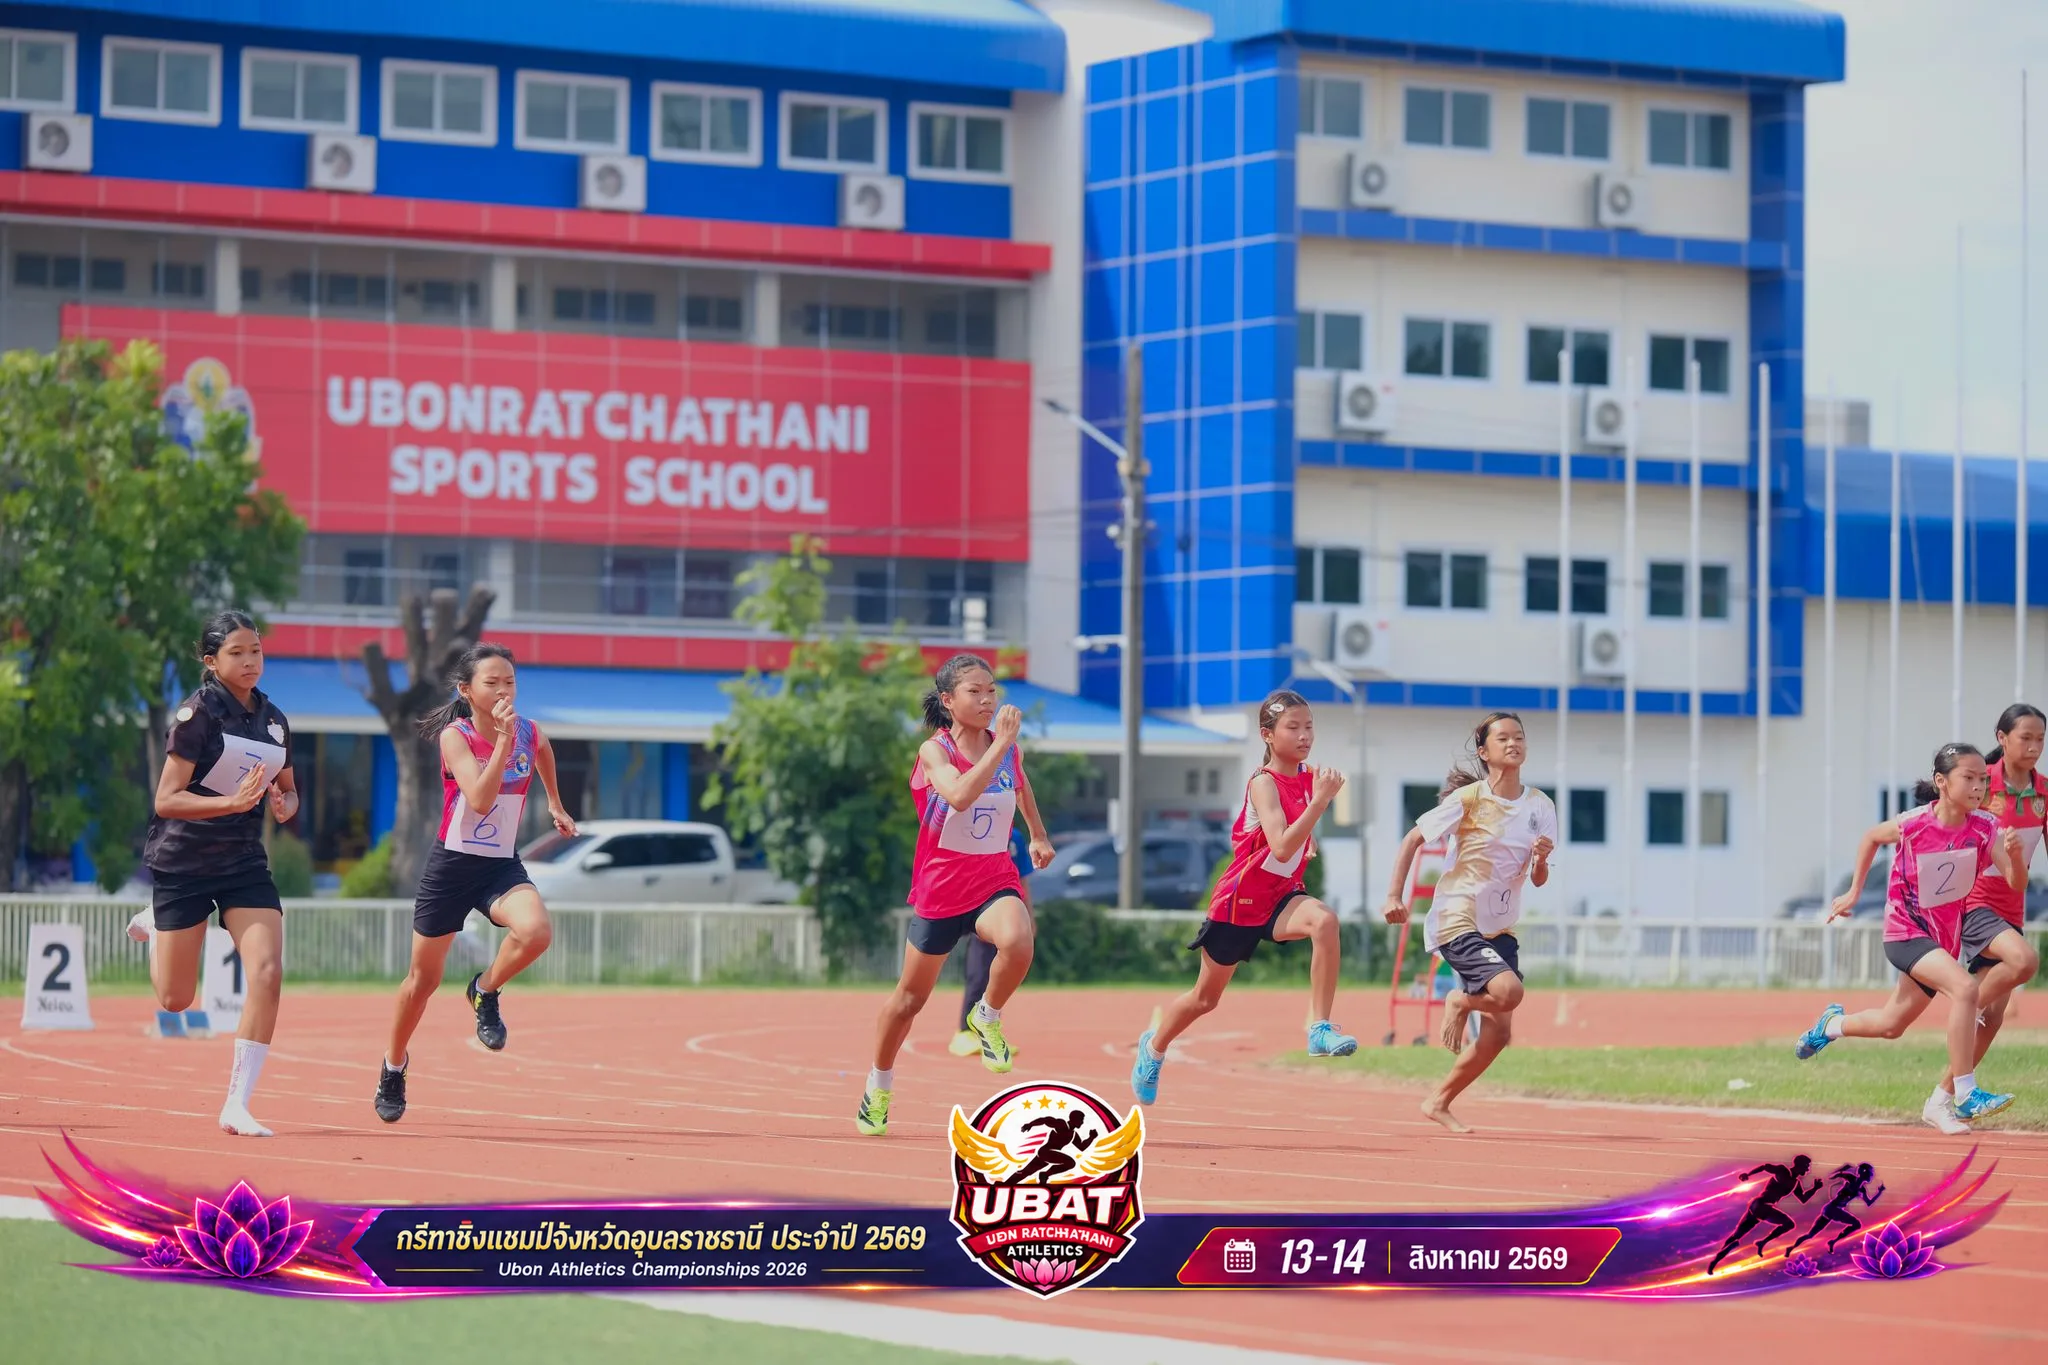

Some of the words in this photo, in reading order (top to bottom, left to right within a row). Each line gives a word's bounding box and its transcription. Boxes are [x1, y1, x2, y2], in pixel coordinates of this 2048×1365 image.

[327, 375, 870, 452] UBONRATCHATHANI
[389, 445, 598, 502] SPORTS
[625, 456, 828, 513] SCHOOL
[473, 803, 499, 840] 6
[970, 807, 997, 840] 5
[1935, 862, 1956, 896] 2
[42, 943, 71, 991] 2
[223, 948, 242, 994] 1
